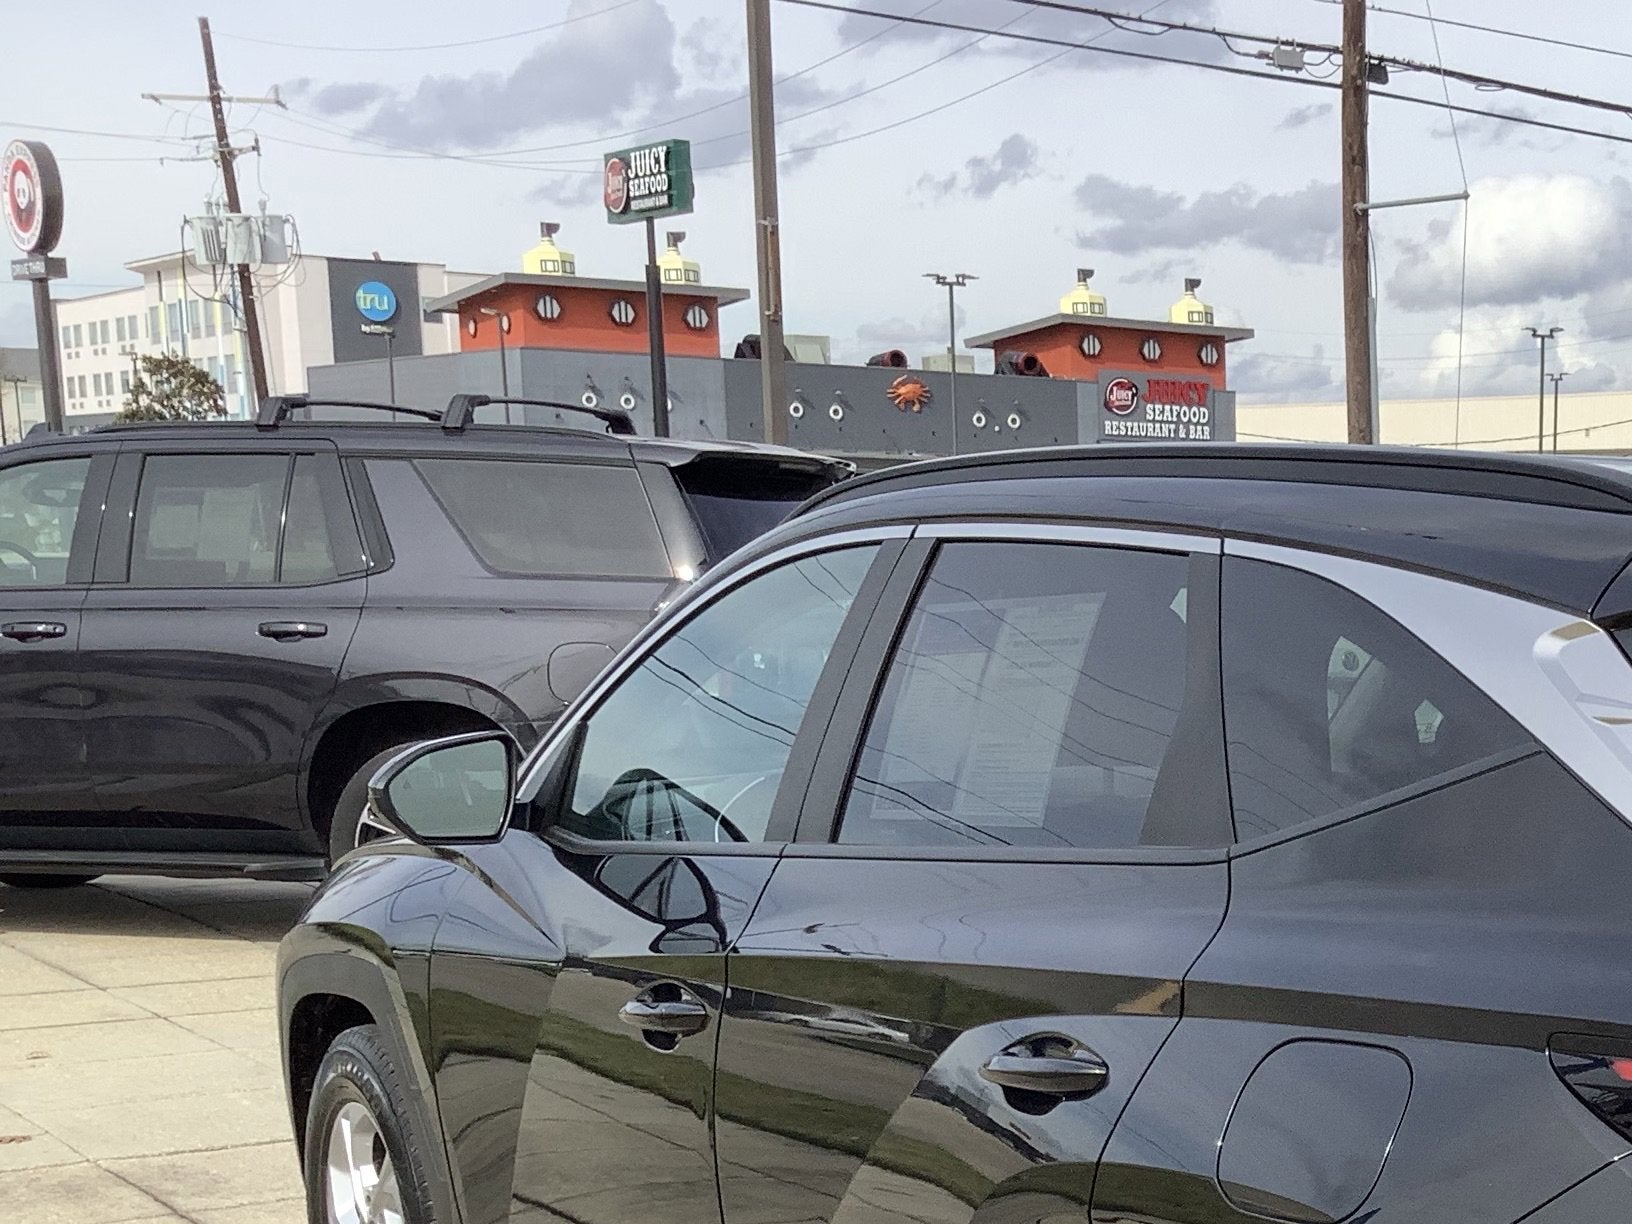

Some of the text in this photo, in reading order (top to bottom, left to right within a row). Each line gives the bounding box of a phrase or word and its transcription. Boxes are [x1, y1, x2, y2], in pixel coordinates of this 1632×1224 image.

[628, 146, 667, 178] JUICY
[629, 174, 668, 197] SEAFOOD
[356, 288, 388, 311] tru
[1142, 379, 1209, 405] JUICY
[1146, 404, 1209, 424] SEAFOOD
[1104, 420, 1211, 440] RESTAURANT & BAR
